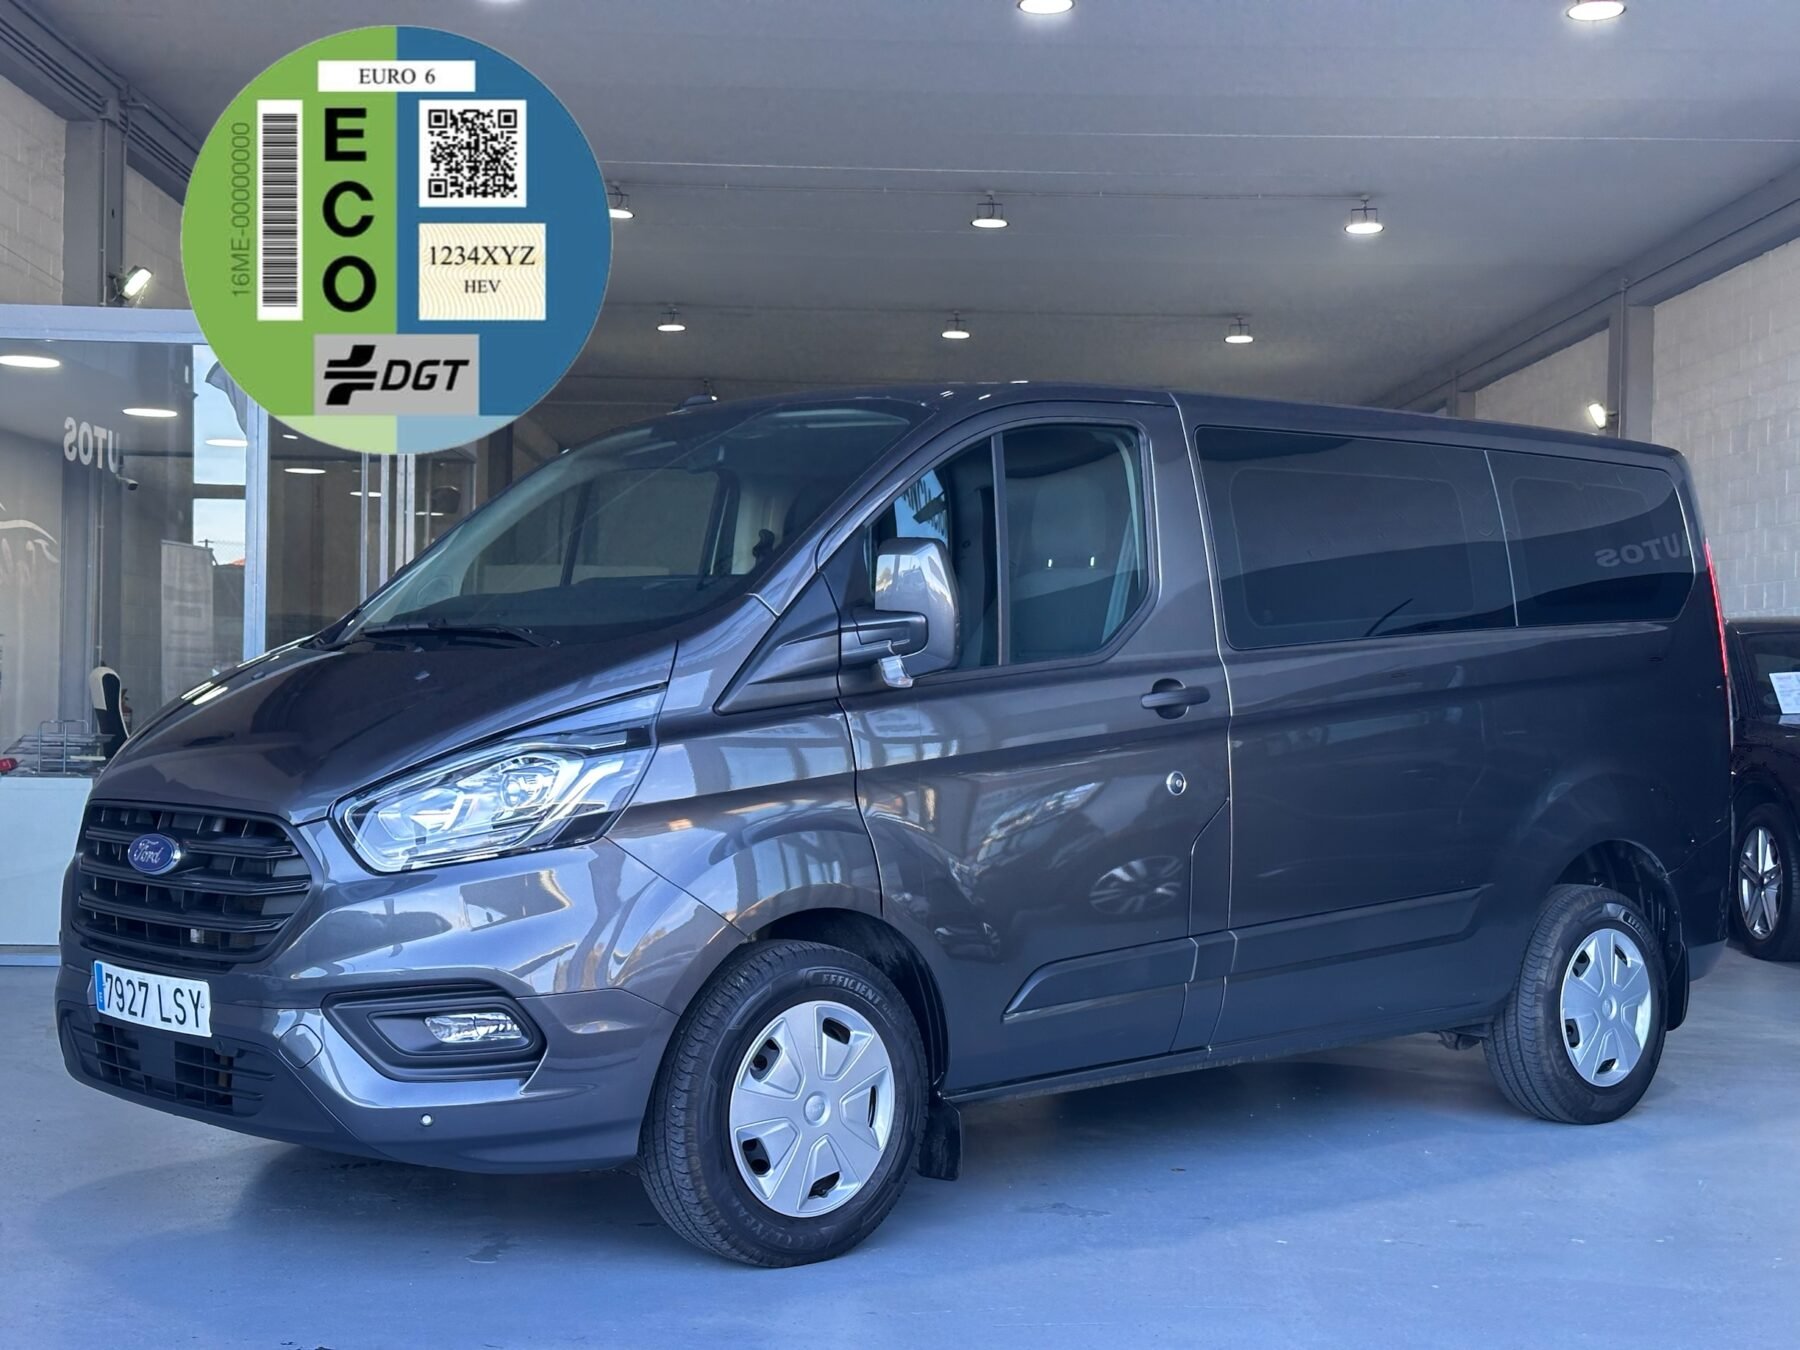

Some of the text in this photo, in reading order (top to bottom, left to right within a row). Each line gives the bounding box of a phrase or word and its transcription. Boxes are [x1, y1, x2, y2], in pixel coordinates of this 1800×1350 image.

[133, 838, 164, 864] Ford
[105, 972, 201, 1028] 7927 LSY
[822, 973, 882, 1004] EFFICIENT
